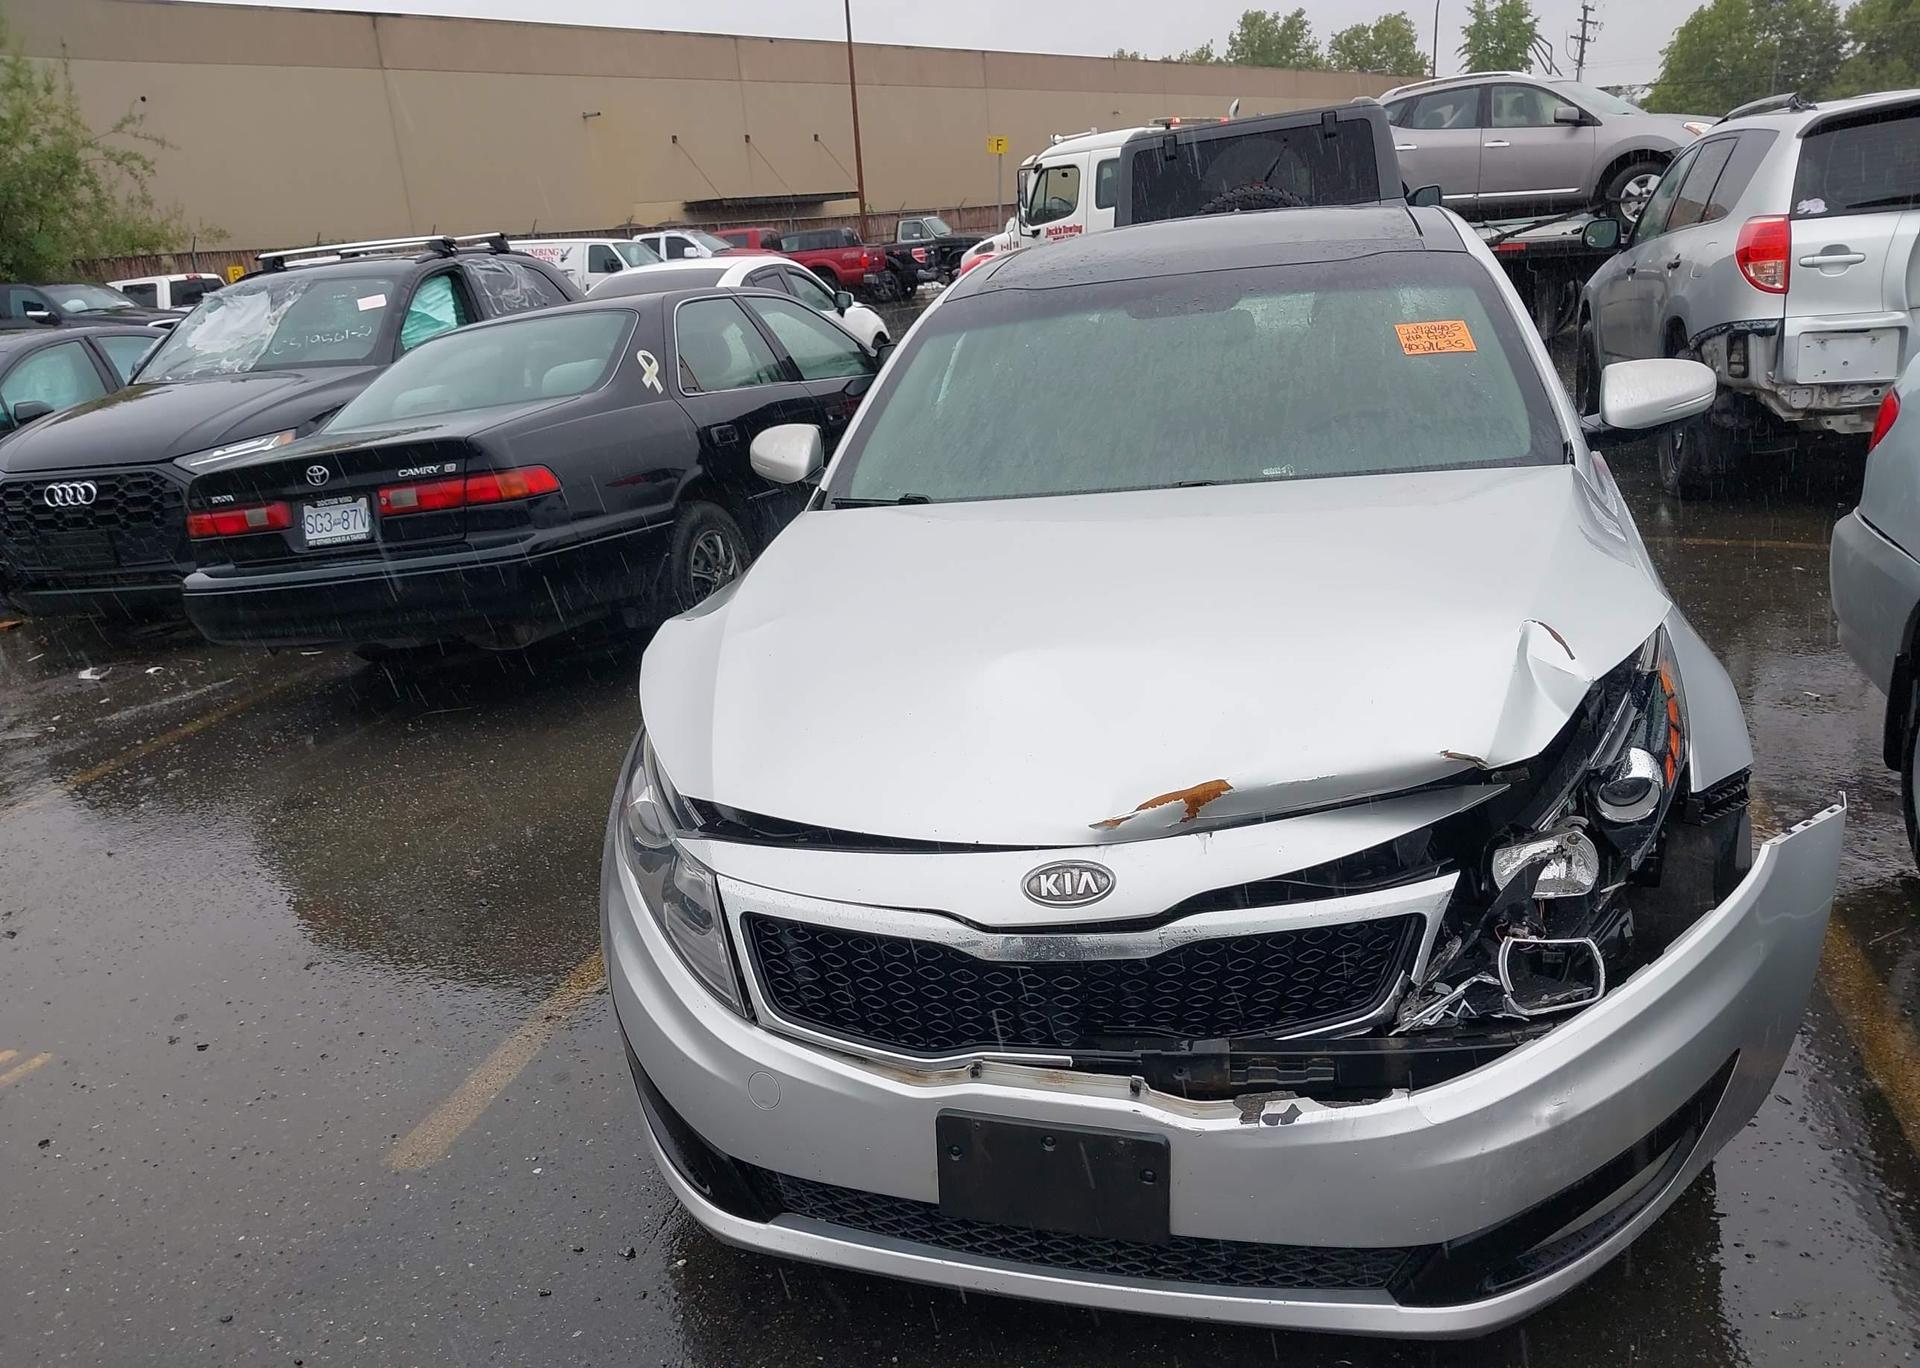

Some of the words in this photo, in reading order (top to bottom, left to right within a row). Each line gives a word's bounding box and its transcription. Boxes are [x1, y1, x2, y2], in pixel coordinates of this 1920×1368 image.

[996, 138, 1004, 152] F
[398, 464, 441, 477] CAMRY
[1039, 871, 1099, 897] KIA
